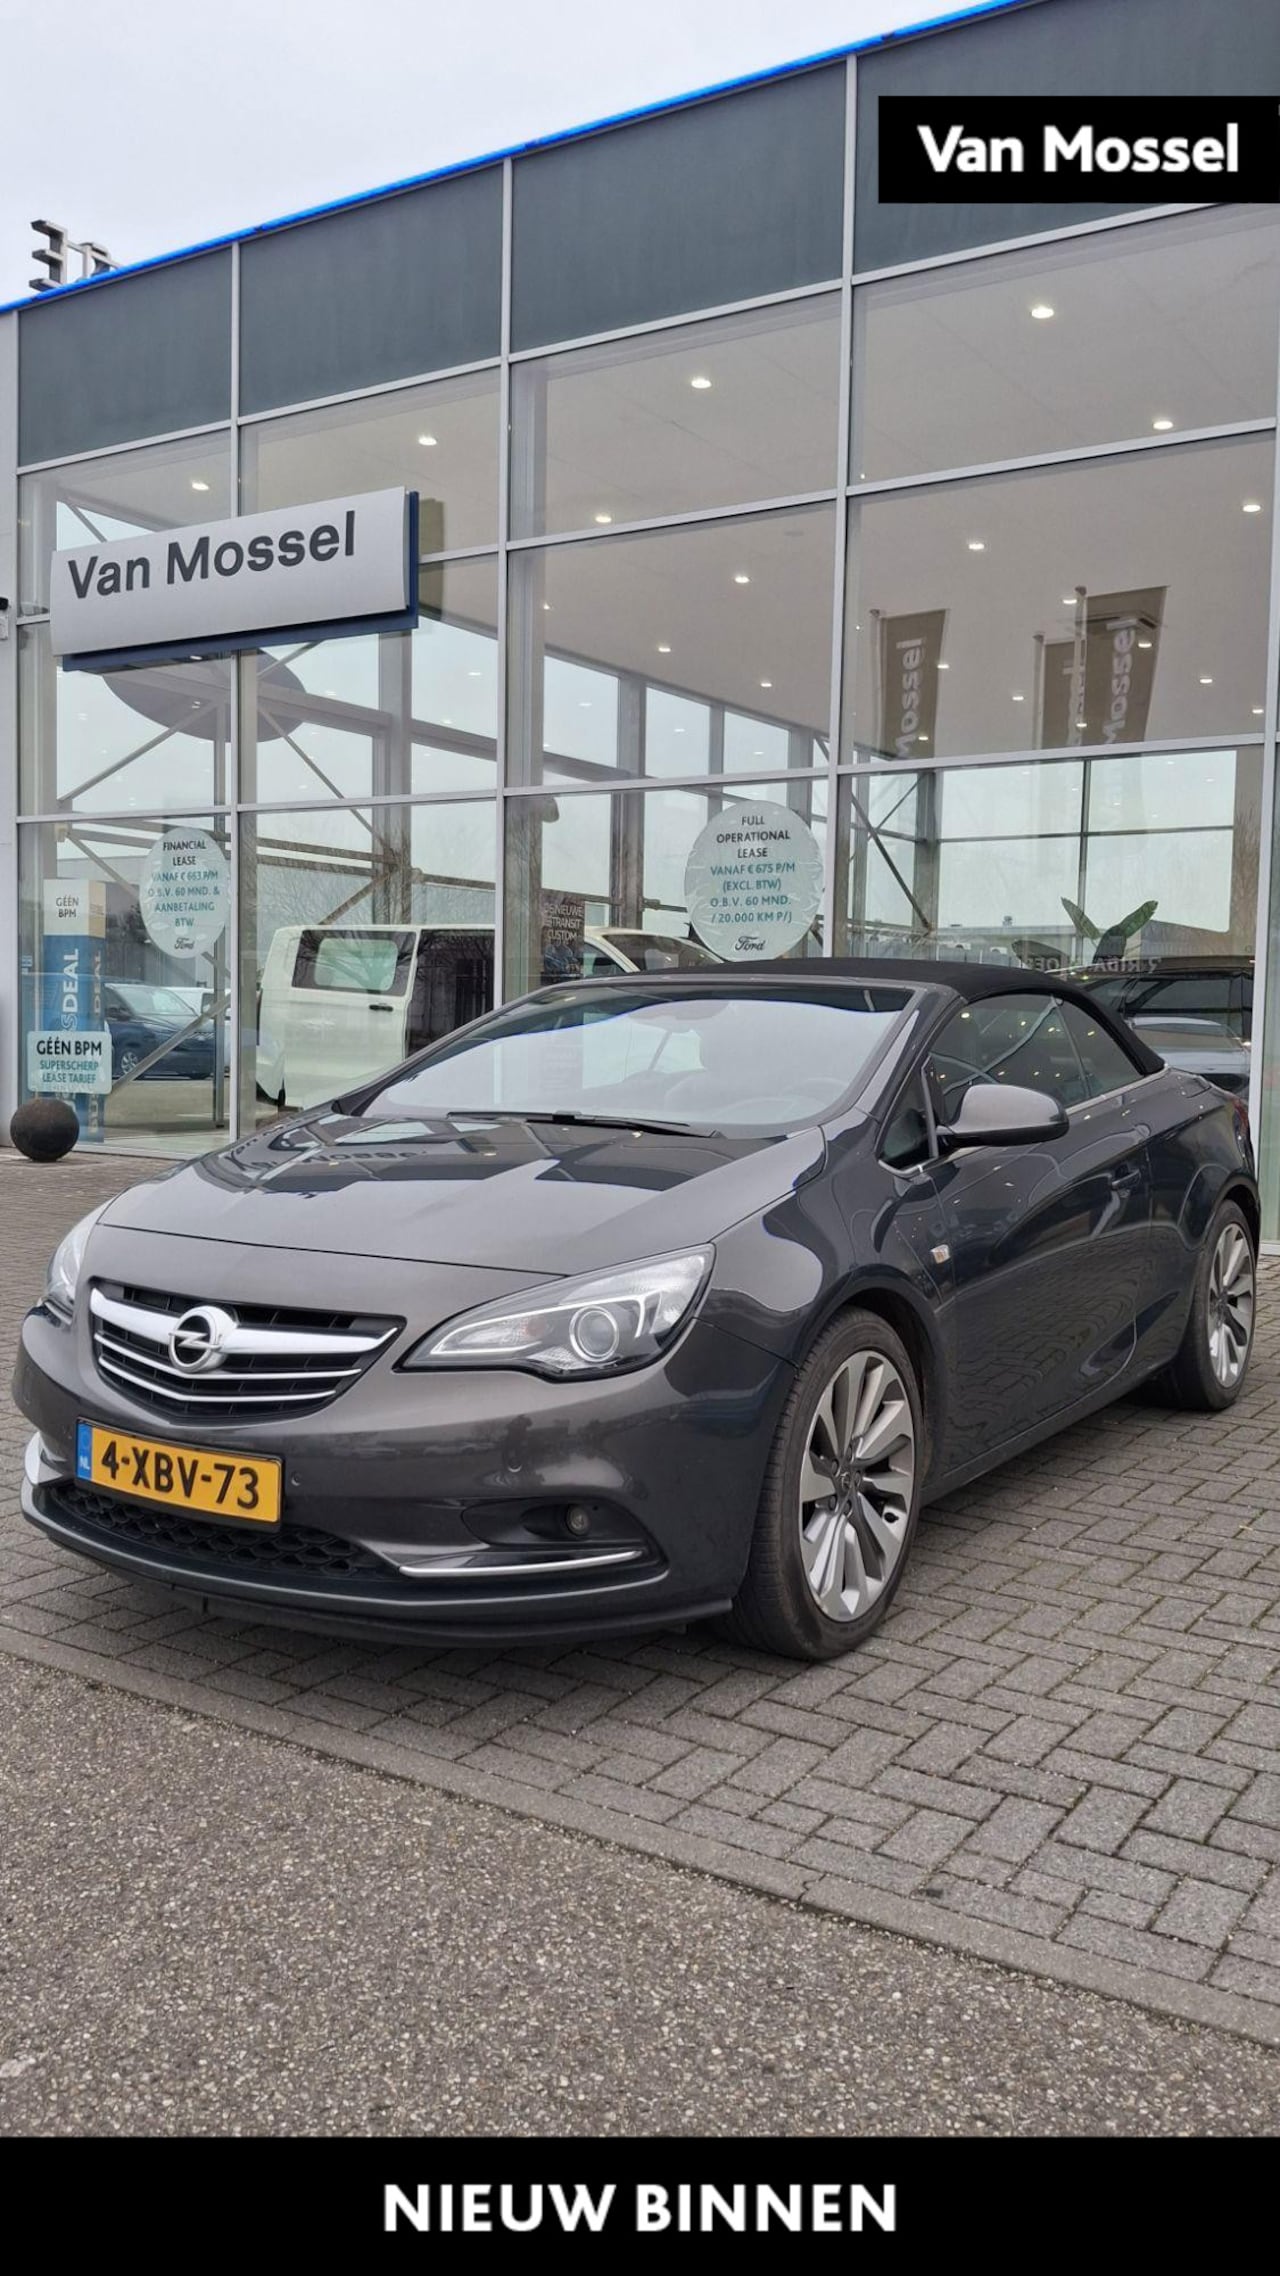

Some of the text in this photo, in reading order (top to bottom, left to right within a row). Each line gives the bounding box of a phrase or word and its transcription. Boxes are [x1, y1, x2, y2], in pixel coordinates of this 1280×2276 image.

[68, 510, 356, 600] Van Mossel
[741, 815, 766, 826] FULL
[716, 830, 791, 844] OPERATIONAL
[162, 840, 207, 851] FINANCIAL
[737, 847, 768, 859] LEASE
[172, 855, 197, 866] LEASE
[710, 862, 796, 876] VANAF € 675 P/M
[151, 871, 179, 882] VANAF
[187, 886, 212, 896] MND.
[213, 886, 220, 896] &
[722, 878, 782, 893] (EXCL. BTW)
[55, 894, 80, 907] GÉÉN
[154, 901, 215, 912] AANBETALING
[710, 895, 792, 908] O.B.V. 60 MND.
[58, 908, 77, 919] BPM
[718, 912, 754, 923] 20.000
[757, 911, 774, 922] KM
[174, 917, 195, 928] BTW
[174, 937, 196, 950] Ford
[735, 935, 766, 951] Ford
[36, 1036, 102, 1057] GÉÉN BPM
[39, 1059, 99, 1071] SUPERSCHERP
[42, 1072, 97, 1084] LEASE TARIEF
[78, 1456, 91, 1471] NL
[101, 1440, 260, 1511] 4-XBV-73
